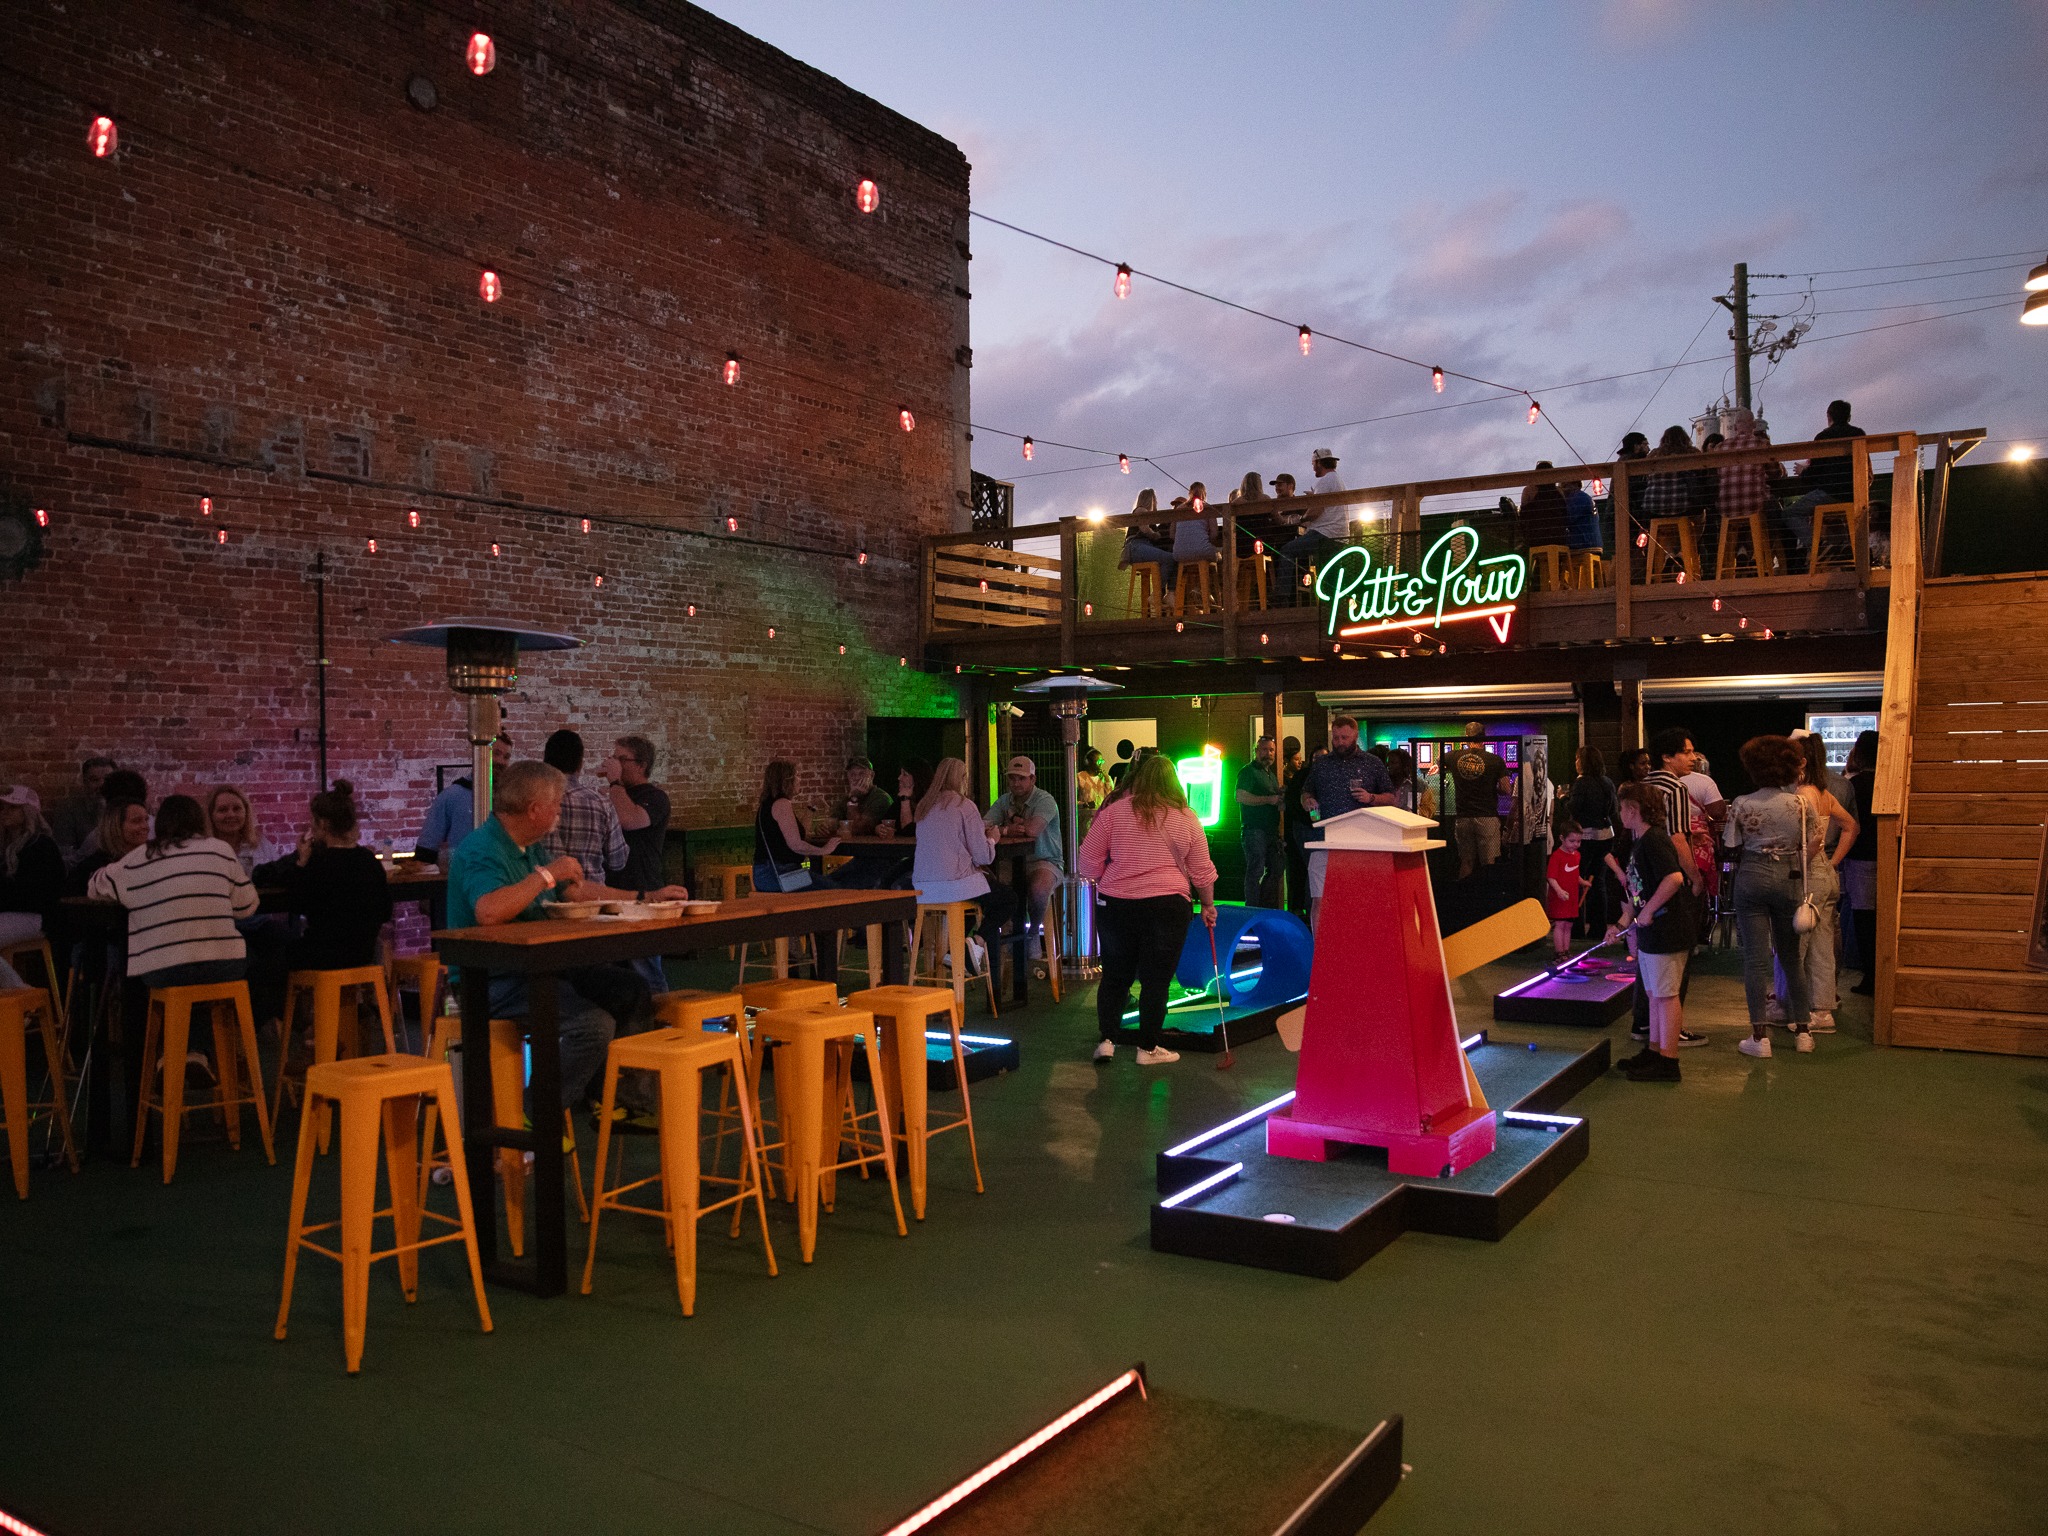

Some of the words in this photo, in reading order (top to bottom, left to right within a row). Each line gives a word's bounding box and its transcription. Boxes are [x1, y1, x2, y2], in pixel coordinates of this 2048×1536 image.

[1316, 546, 1409, 635] Putt
[1394, 577, 1433, 616] &
[1421, 526, 1526, 629] Pour
